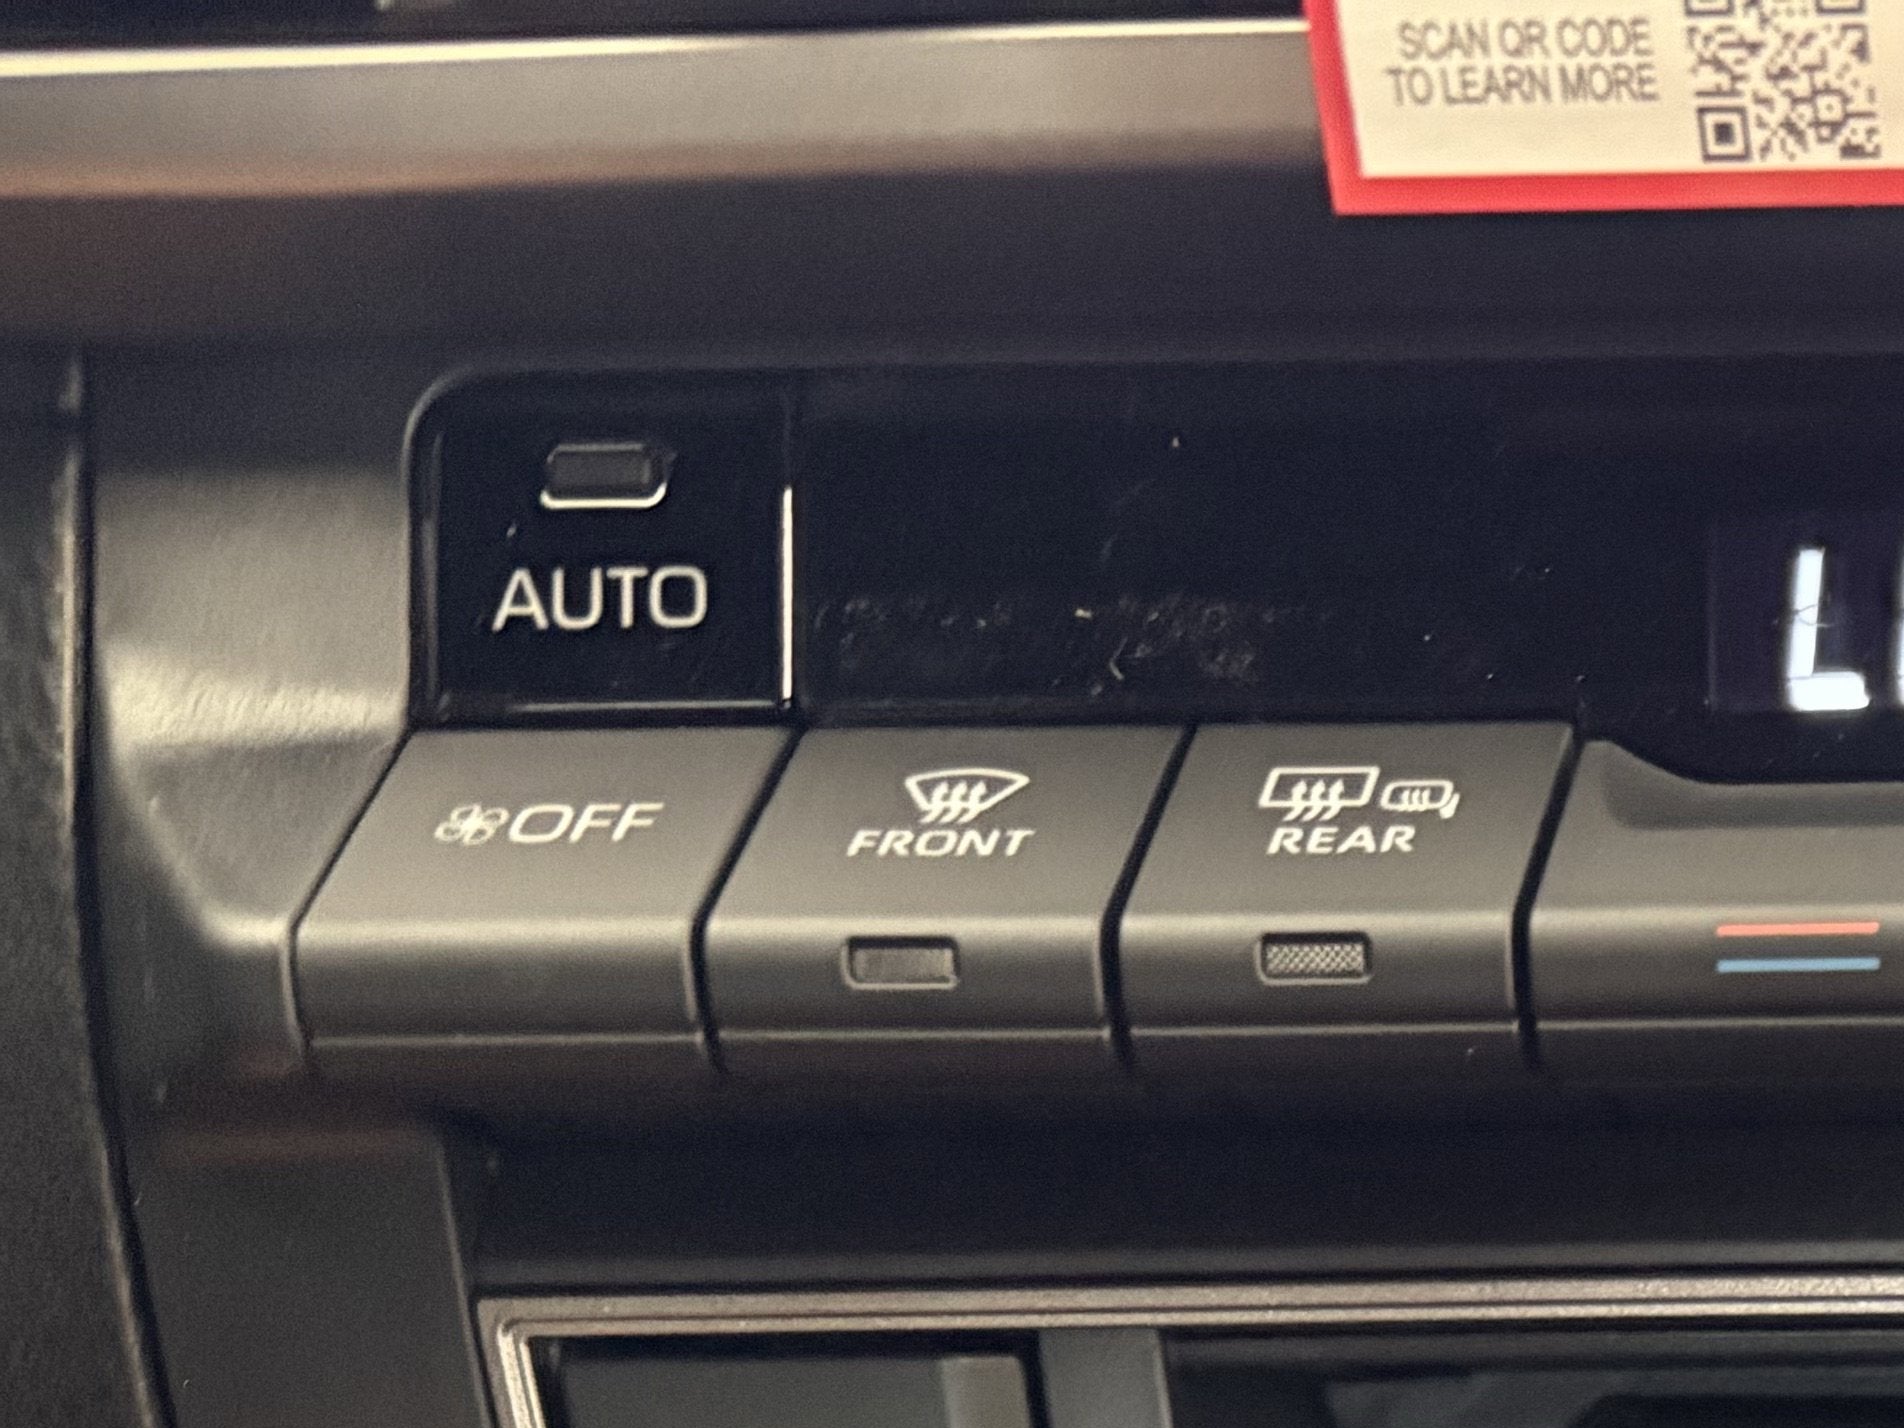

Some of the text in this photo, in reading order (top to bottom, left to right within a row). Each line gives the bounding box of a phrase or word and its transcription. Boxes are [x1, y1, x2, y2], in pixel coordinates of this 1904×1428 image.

[1399, 17, 1653, 60] SCAN QR CODE
[1385, 62, 1659, 106] TO LEARN MORE
[493, 566, 706, 630] AUTO
[508, 803, 663, 843] OFF
[847, 820, 1033, 856] FRONT
[1267, 822, 1415, 854] REAR
